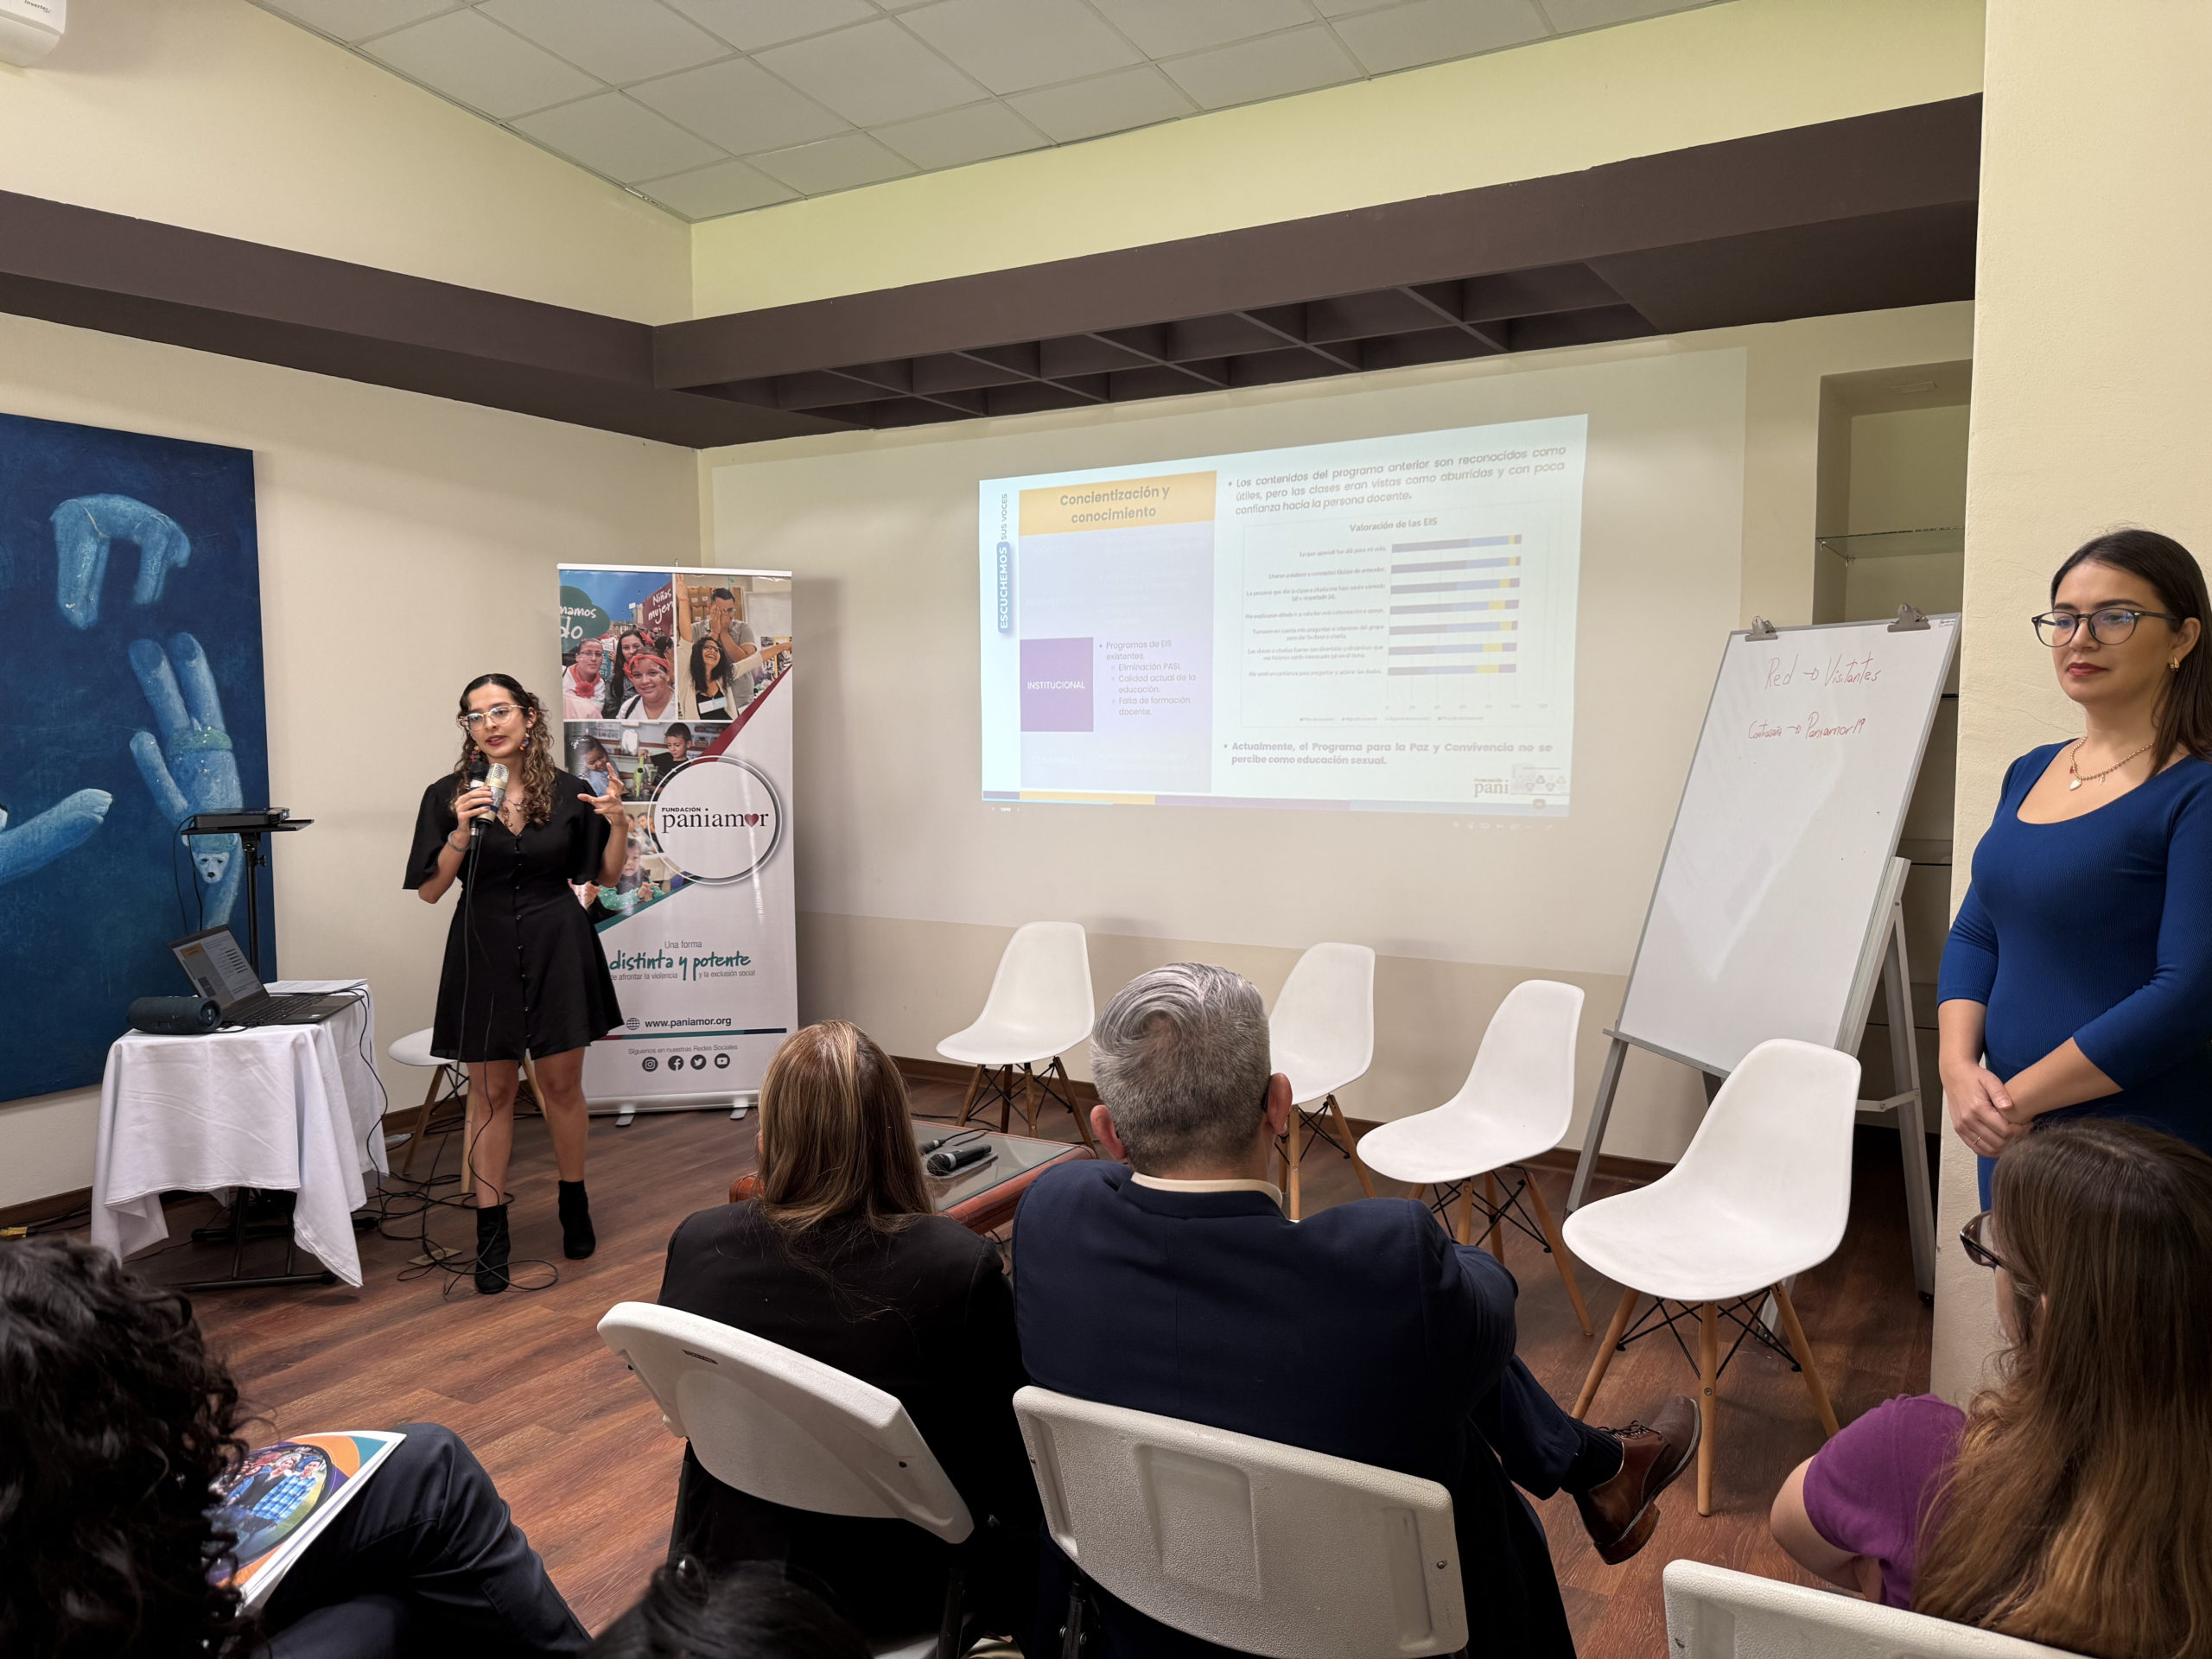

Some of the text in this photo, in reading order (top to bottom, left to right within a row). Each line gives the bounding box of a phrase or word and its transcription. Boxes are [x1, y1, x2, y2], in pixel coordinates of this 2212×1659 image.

[1236, 446, 1567, 488] Los contenidos del programa anterior son reconocidos como
[1236, 490, 1262, 501] útiles,
[1266, 489, 1287, 501] pero
[1291, 486, 1306, 497] las
[1309, 483, 1340, 496] clases
[1344, 480, 1368, 491] eran
[1371, 476, 1401, 488] vistas
[1406, 474, 1436, 485] como
[1497, 467, 1504, 478] y
[1534, 461, 1565, 474] poca
[1060, 485, 1171, 505] Concientización y
[1236, 491, 1412, 515] confianza hacia la persona docente.
[1071, 506, 1156, 524] conocimiento
[1350, 518, 1394, 532] Valoración
[1395, 519, 1407, 528] de
[1408, 518, 1421, 527] las
[1000, 546, 1008, 629] ESCUCHEMOS
[652, 588, 672, 606] Niñas
[1106, 639, 1172, 652] Programas de EIS
[1118, 663, 1161, 671] Eliminación
[1765, 651, 1881, 690] Red Visitantes
[1027, 680, 1085, 690] INSTITUCIONAL
[1118, 674, 1148, 683] Calidad
[1150, 673, 1174, 682] actual
[1176, 673, 1186, 682] de
[1118, 696, 1191, 705] Falta de formación
[1232, 742, 1553, 754] Actualmente, el Programa para la Paz y Convivencia no se
[1231, 754, 1267, 765] percibe
[1297, 754, 1349, 765] educación
[1351, 755, 1387, 765] sexual.
[664, 940, 702, 949] Una forma
[609, 949, 751, 981] distinta y potente
[645, 1018, 732, 1028] www.paniamor.org
